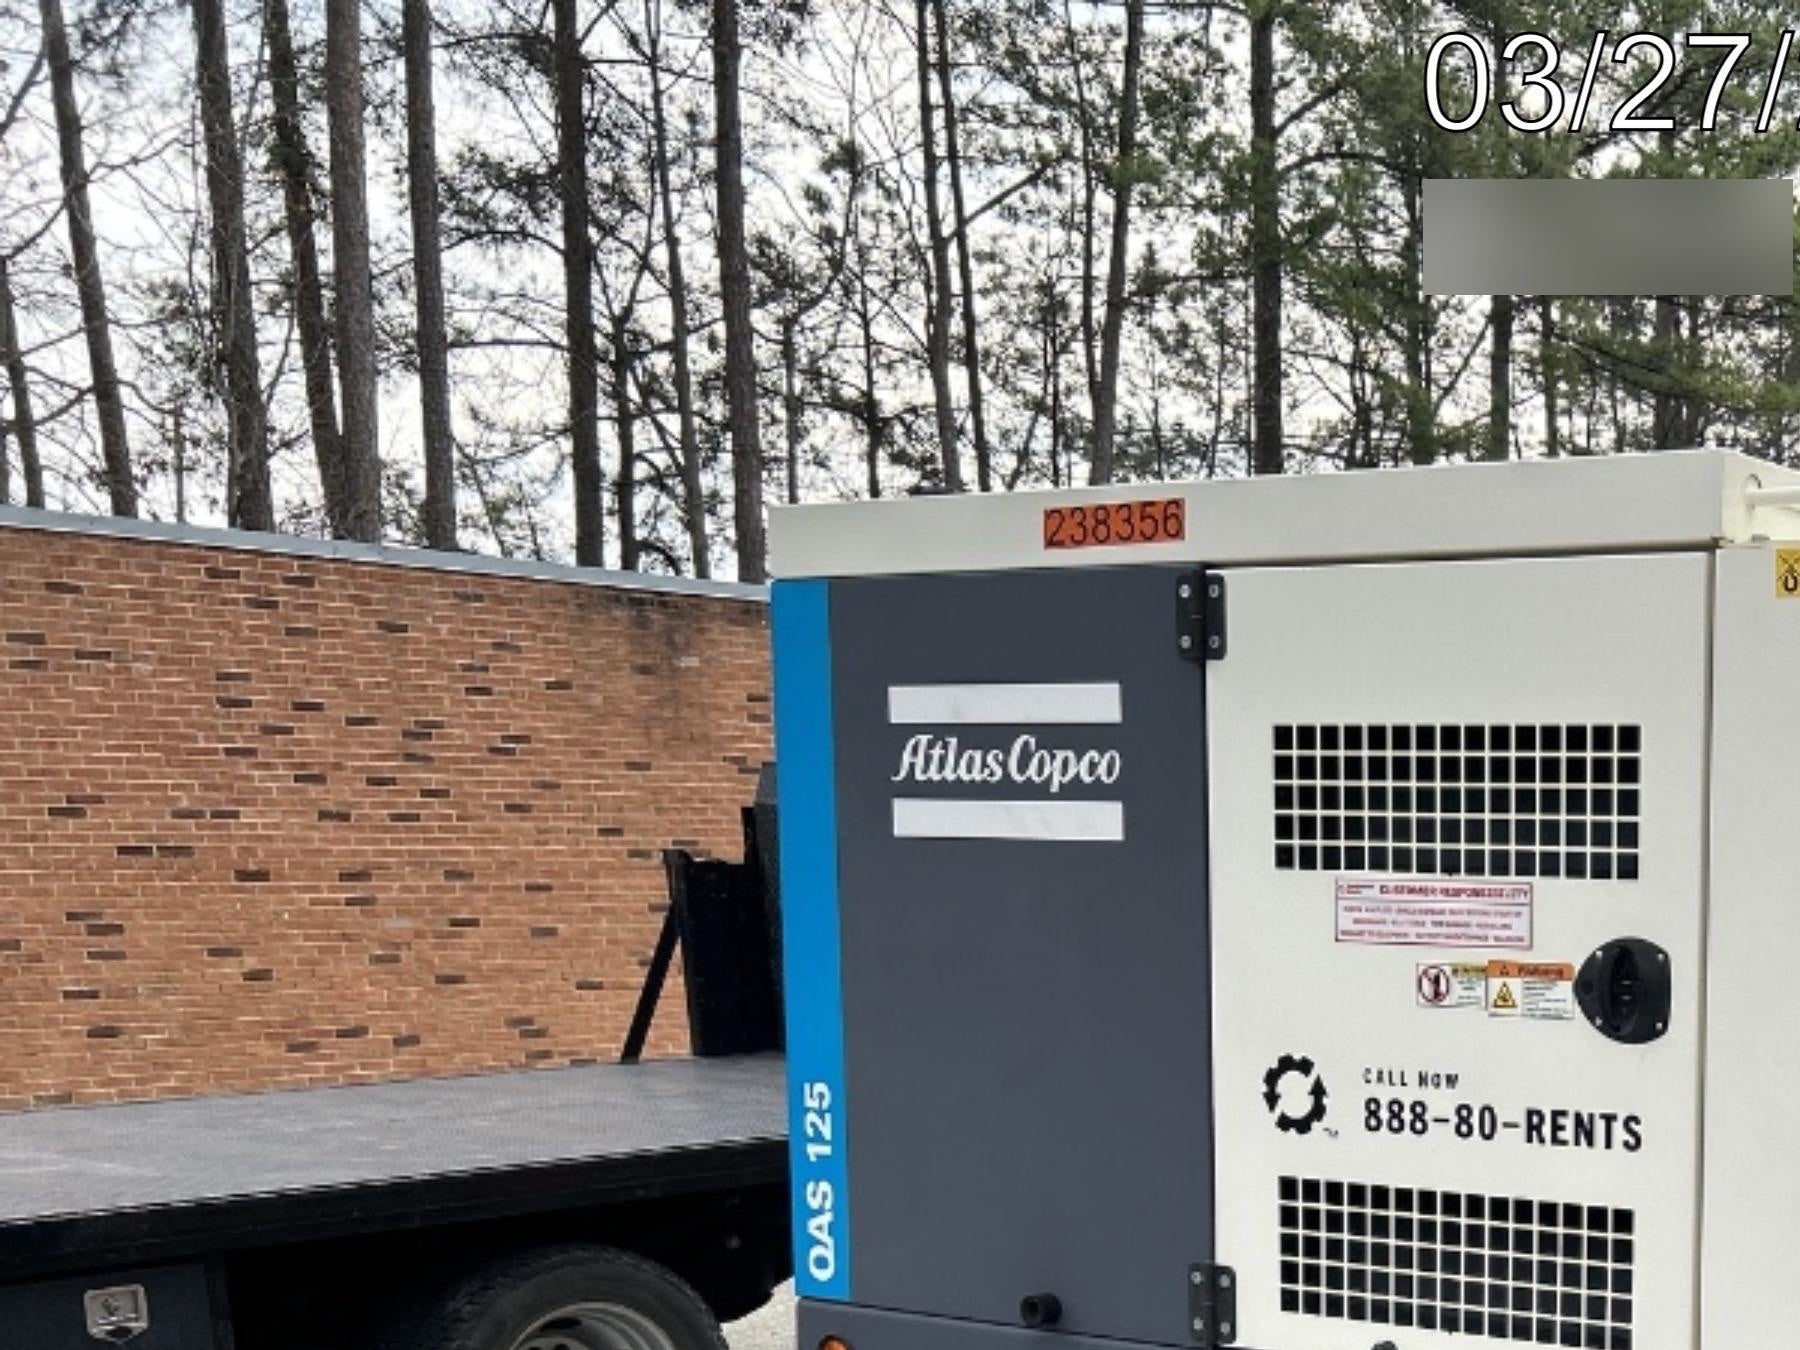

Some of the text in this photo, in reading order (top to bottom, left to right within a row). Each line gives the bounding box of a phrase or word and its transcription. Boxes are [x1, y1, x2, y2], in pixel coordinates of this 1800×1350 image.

[1046, 499, 1184, 547] 238356
[890, 734, 1121, 793] Atlas Copco
[1363, 1067, 1460, 1090] CALL NOW
[803, 1081, 833, 1163] 125
[1363, 1097, 1644, 1152] 888-80-RENTS
